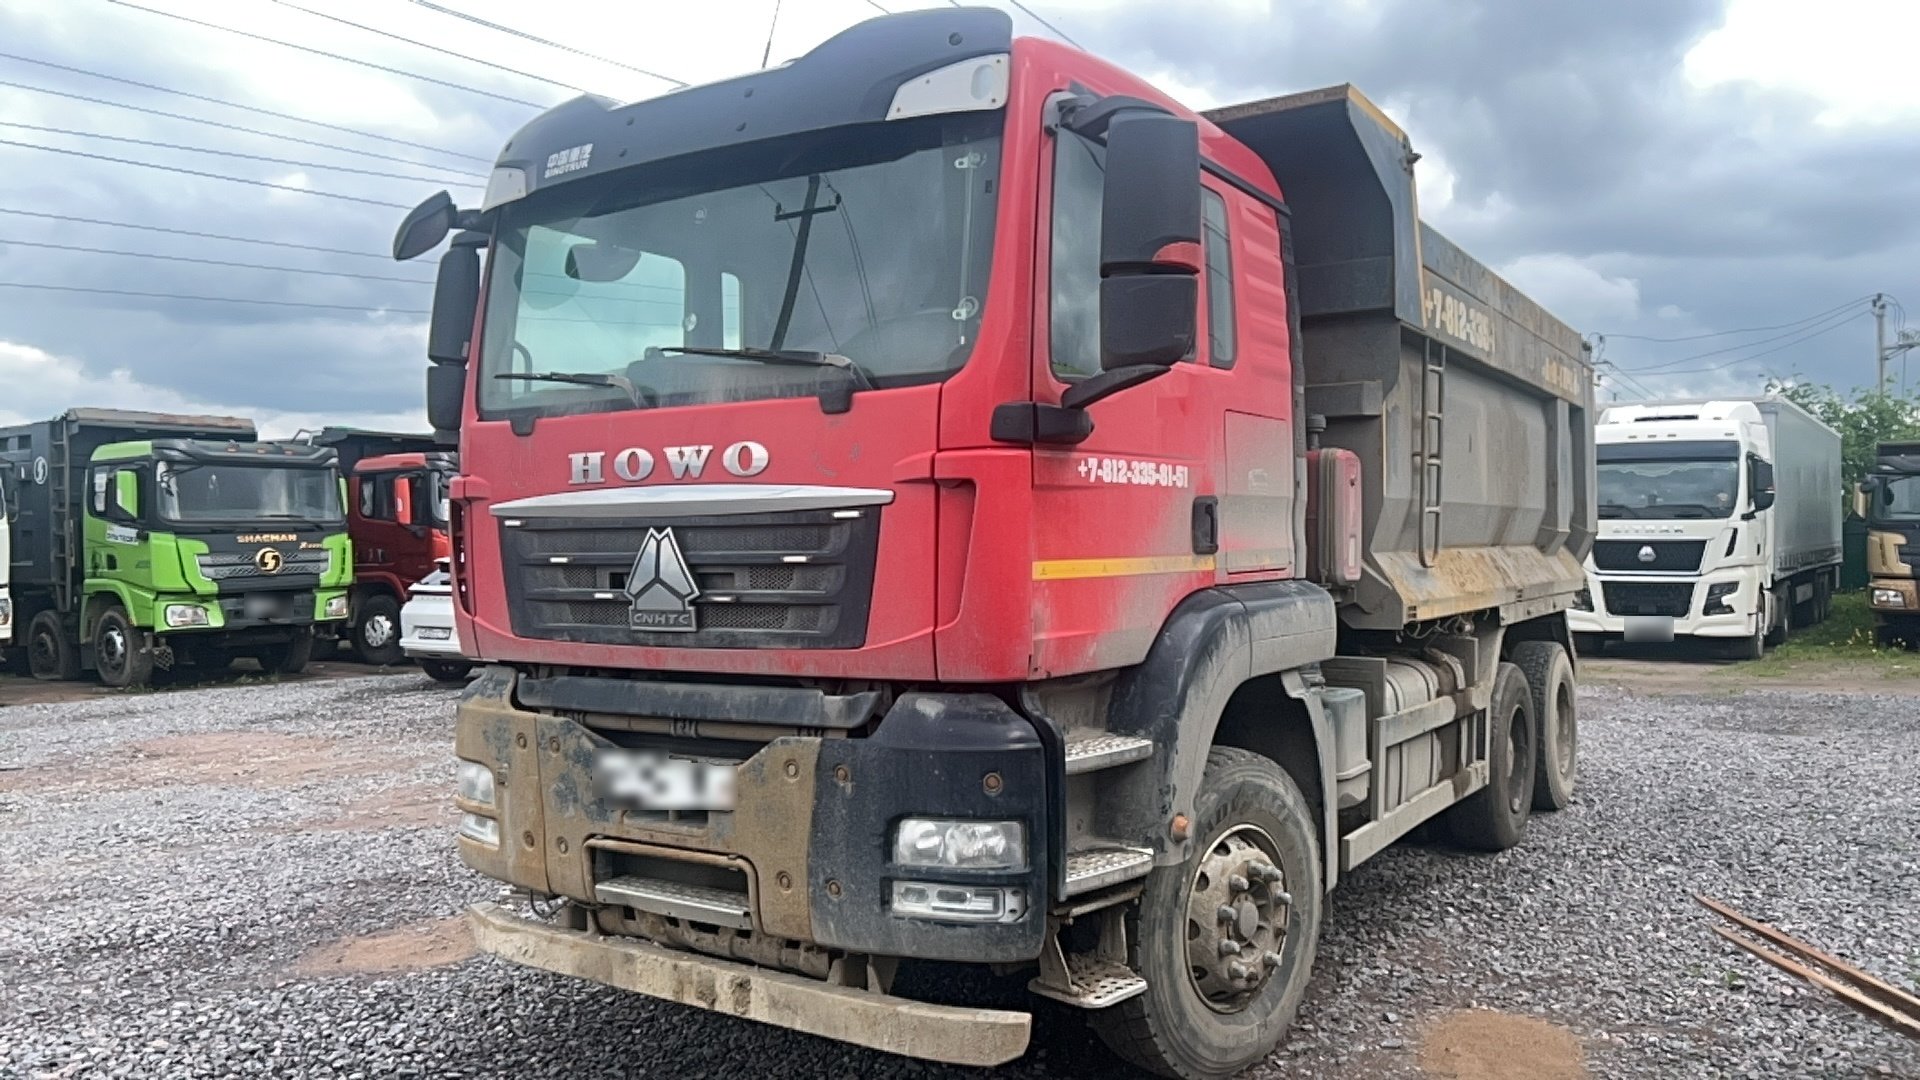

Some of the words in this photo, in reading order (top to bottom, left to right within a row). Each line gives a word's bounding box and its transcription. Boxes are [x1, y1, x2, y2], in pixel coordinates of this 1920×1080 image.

[568, 441, 770, 485] HOWO
[1078, 457, 1189, 488] +7-812-335-81-51
[236, 533, 298, 543] SHACMAN
[633, 613, 690, 625] CNHTC
